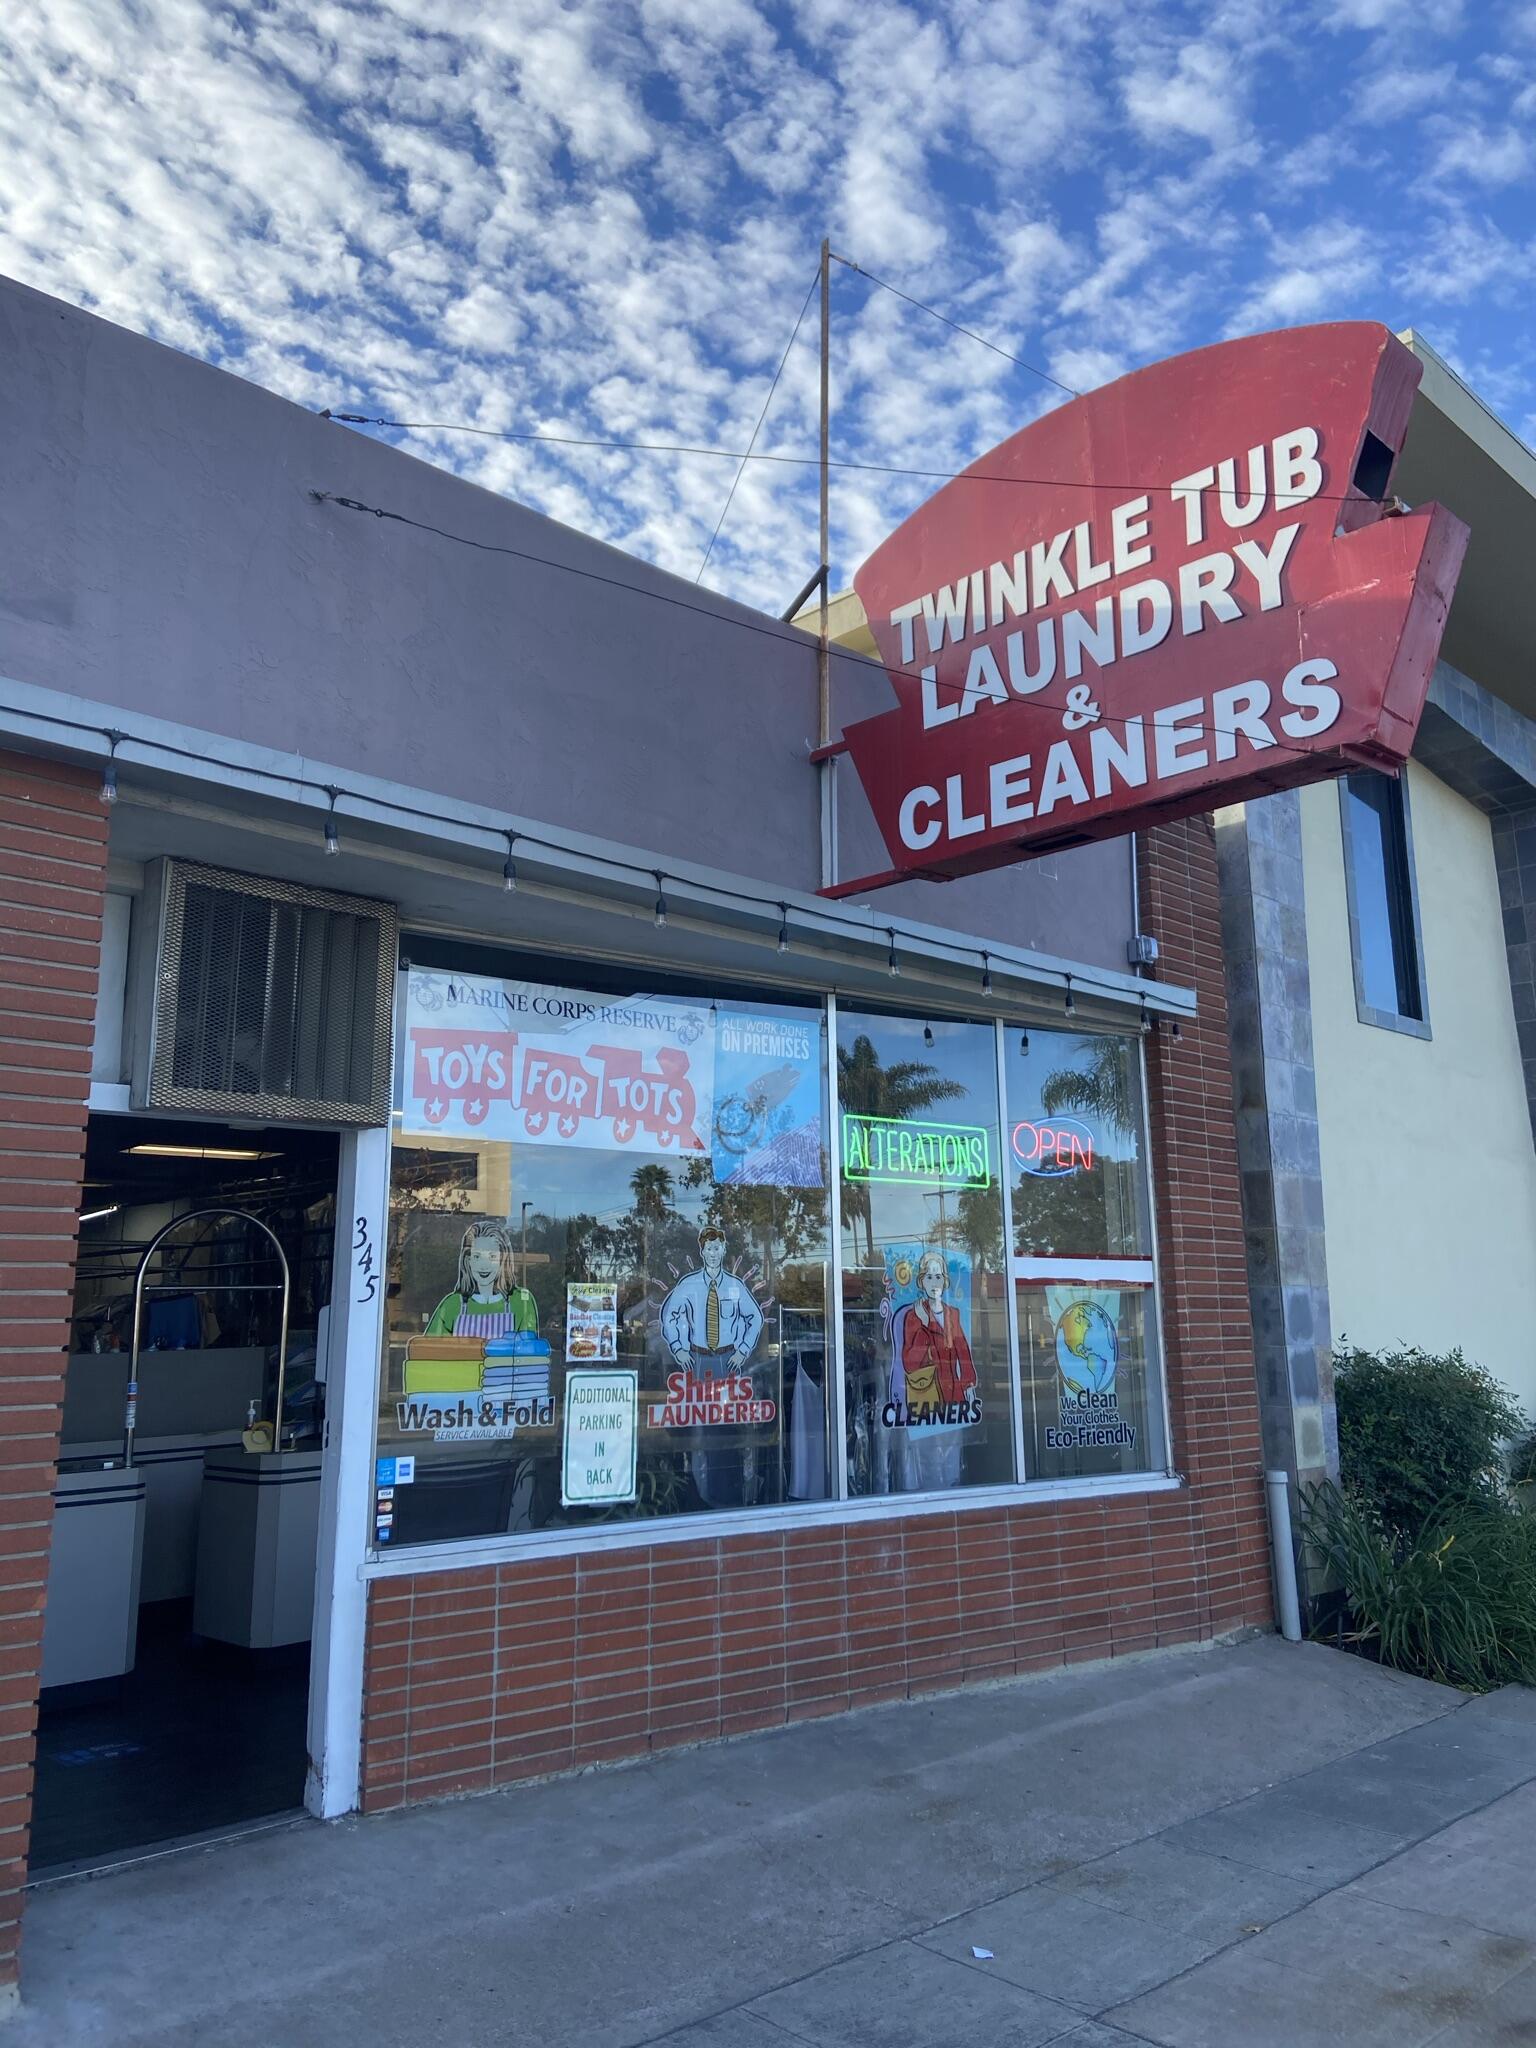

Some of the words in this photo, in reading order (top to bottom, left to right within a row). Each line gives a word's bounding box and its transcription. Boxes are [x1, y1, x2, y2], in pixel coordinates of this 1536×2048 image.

[889, 495, 1153, 666] TWINKLE
[1170, 425, 1324, 546] TUB
[920, 522, 1301, 731] LAUNDRY
[1061, 683, 1103, 731] &
[898, 656, 1342, 851] CLEANERS
[446, 984, 529, 1012] MARINE
[532, 996, 597, 1022] CORPS
[600, 1005, 677, 1033] RESERVE
[721, 1018, 744, 1031] ALL
[745, 1020, 778, 1035] WORK
[780, 1024, 809, 1039] DONE
[721, 1029, 741, 1053] ON
[743, 1032, 810, 1060] PREMISES
[420, 1042, 507, 1090] TOYS
[526, 1060, 589, 1110] FOR
[608, 1076, 684, 1126] TOTS
[848, 1125, 985, 1178] ALTERATIONS
[1012, 1121, 1093, 1171] OPEN
[352, 1216, 380, 1304] 345
[572, 1386, 632, 1405] ADDITIONAL
[667, 1368, 753, 1405] Shirts
[1060, 1396, 1077, 1410] We
[1077, 1387, 1119, 1409] Clean
[397, 1399, 474, 1431] Wash
[477, 1401, 498, 1428] &
[501, 1396, 555, 1427] Fold
[579, 1413, 623, 1432] PARKING
[649, 1401, 776, 1428] LAUNDERED
[881, 1399, 983, 1429] CLEANERS
[1060, 1412, 1083, 1426] Your
[1084, 1409, 1120, 1425] Clothes
[435, 1429, 469, 1440] SERVICE
[469, 1427, 514, 1440] AVAILABLE
[594, 1440, 606, 1458] IN
[1045, 1422, 1136, 1450] Eco-Friendly
[586, 1467, 613, 1486] BACK
